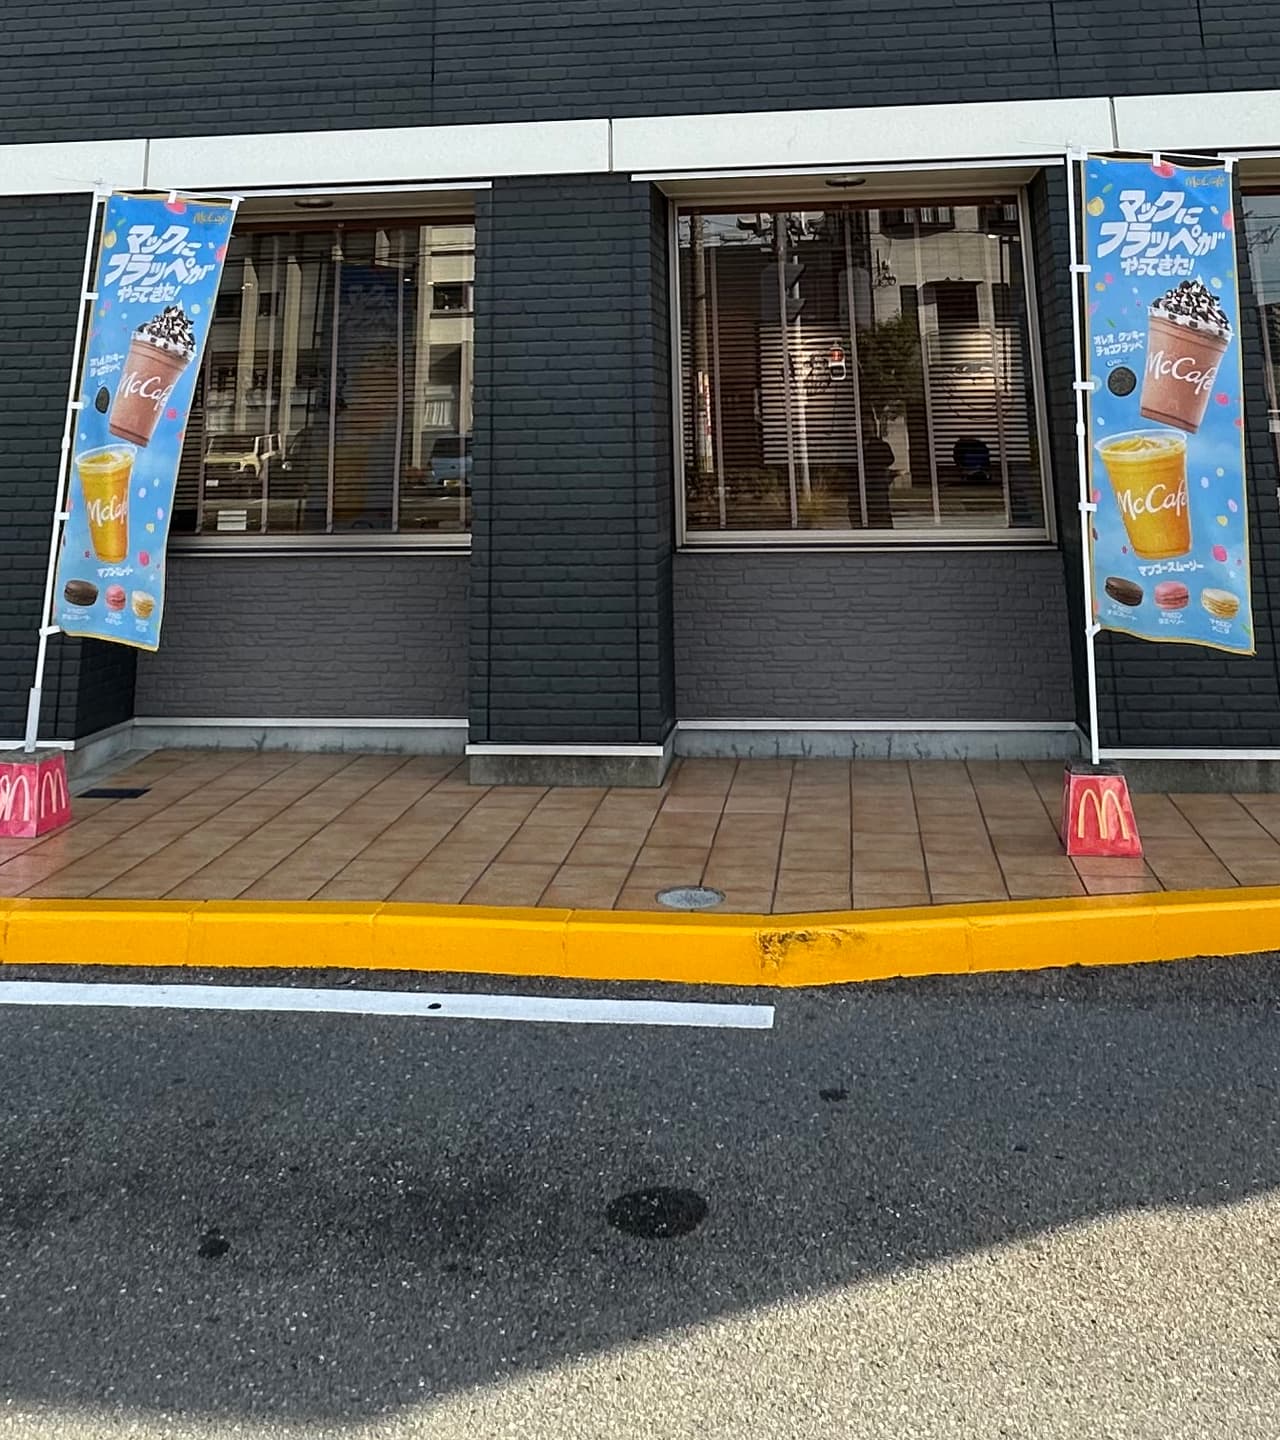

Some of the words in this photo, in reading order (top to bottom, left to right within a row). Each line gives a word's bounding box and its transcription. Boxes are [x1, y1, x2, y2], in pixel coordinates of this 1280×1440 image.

[1119, 190, 1203, 224] マックに
[127, 225, 202, 257] マックに
[1097, 221, 1225, 258] フラッペが
[104, 253, 215, 287] フラッペが
